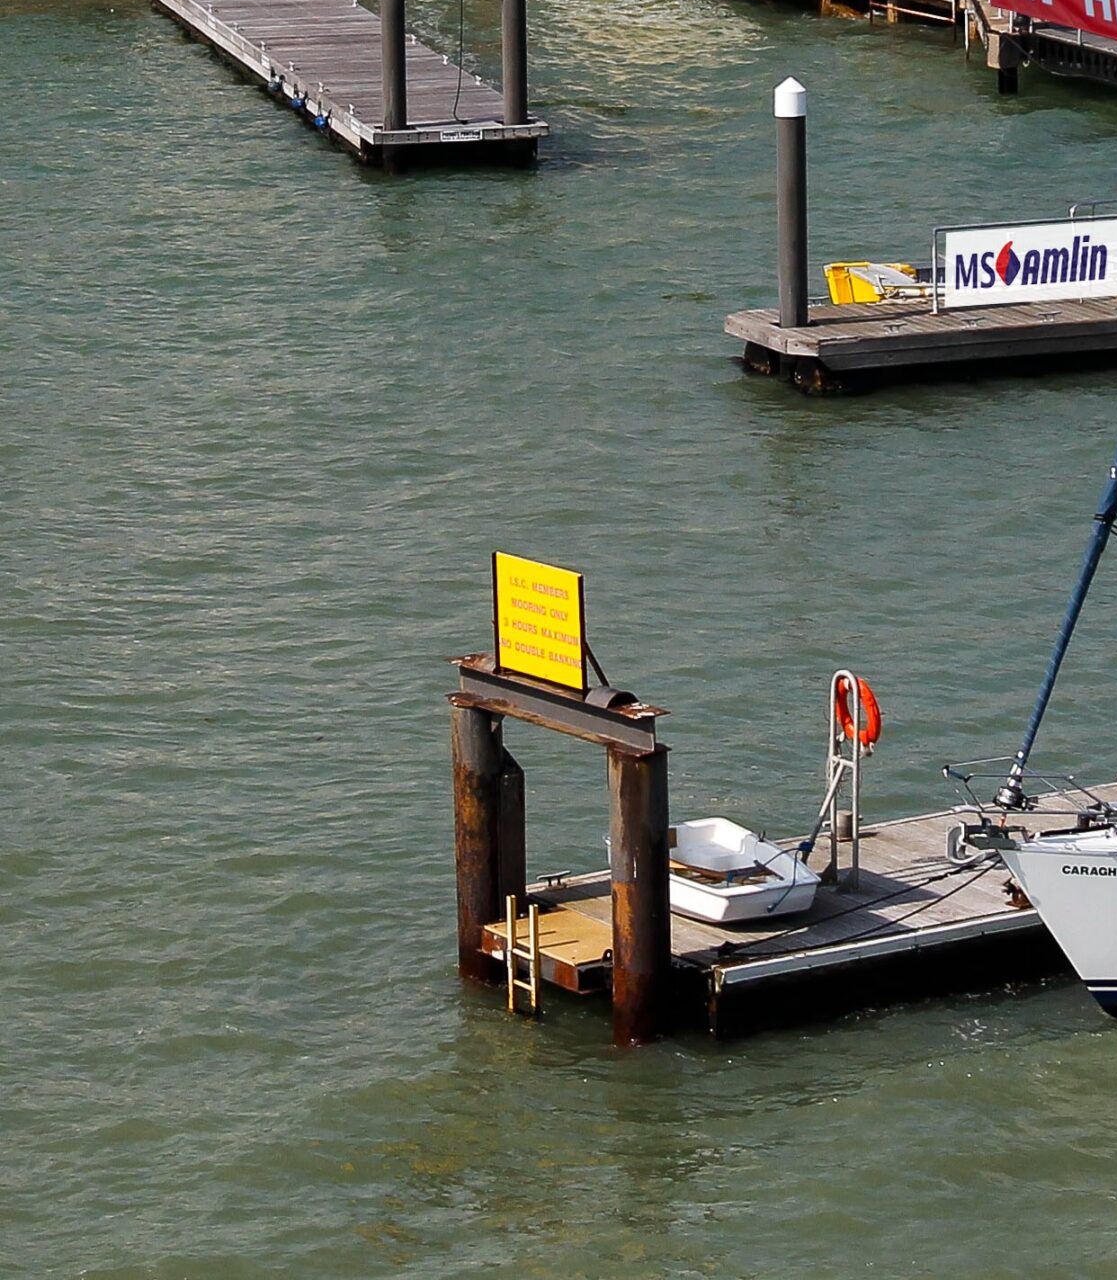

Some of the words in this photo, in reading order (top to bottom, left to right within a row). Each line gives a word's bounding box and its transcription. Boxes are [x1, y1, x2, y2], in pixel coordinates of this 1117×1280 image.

[955, 251, 996, 290] MS
[532, 582, 570, 600] MEMBERS
[511, 598, 547, 616] MOORING
[550, 608, 569, 621] ONLY
[512, 619, 538, 635] HOURS
[541, 627, 580, 647] MAXIMUM
[501, 637, 512, 649] NO
[514, 641, 546, 659] DOUBLE
[1062, 864, 1117, 877] CARAGH
